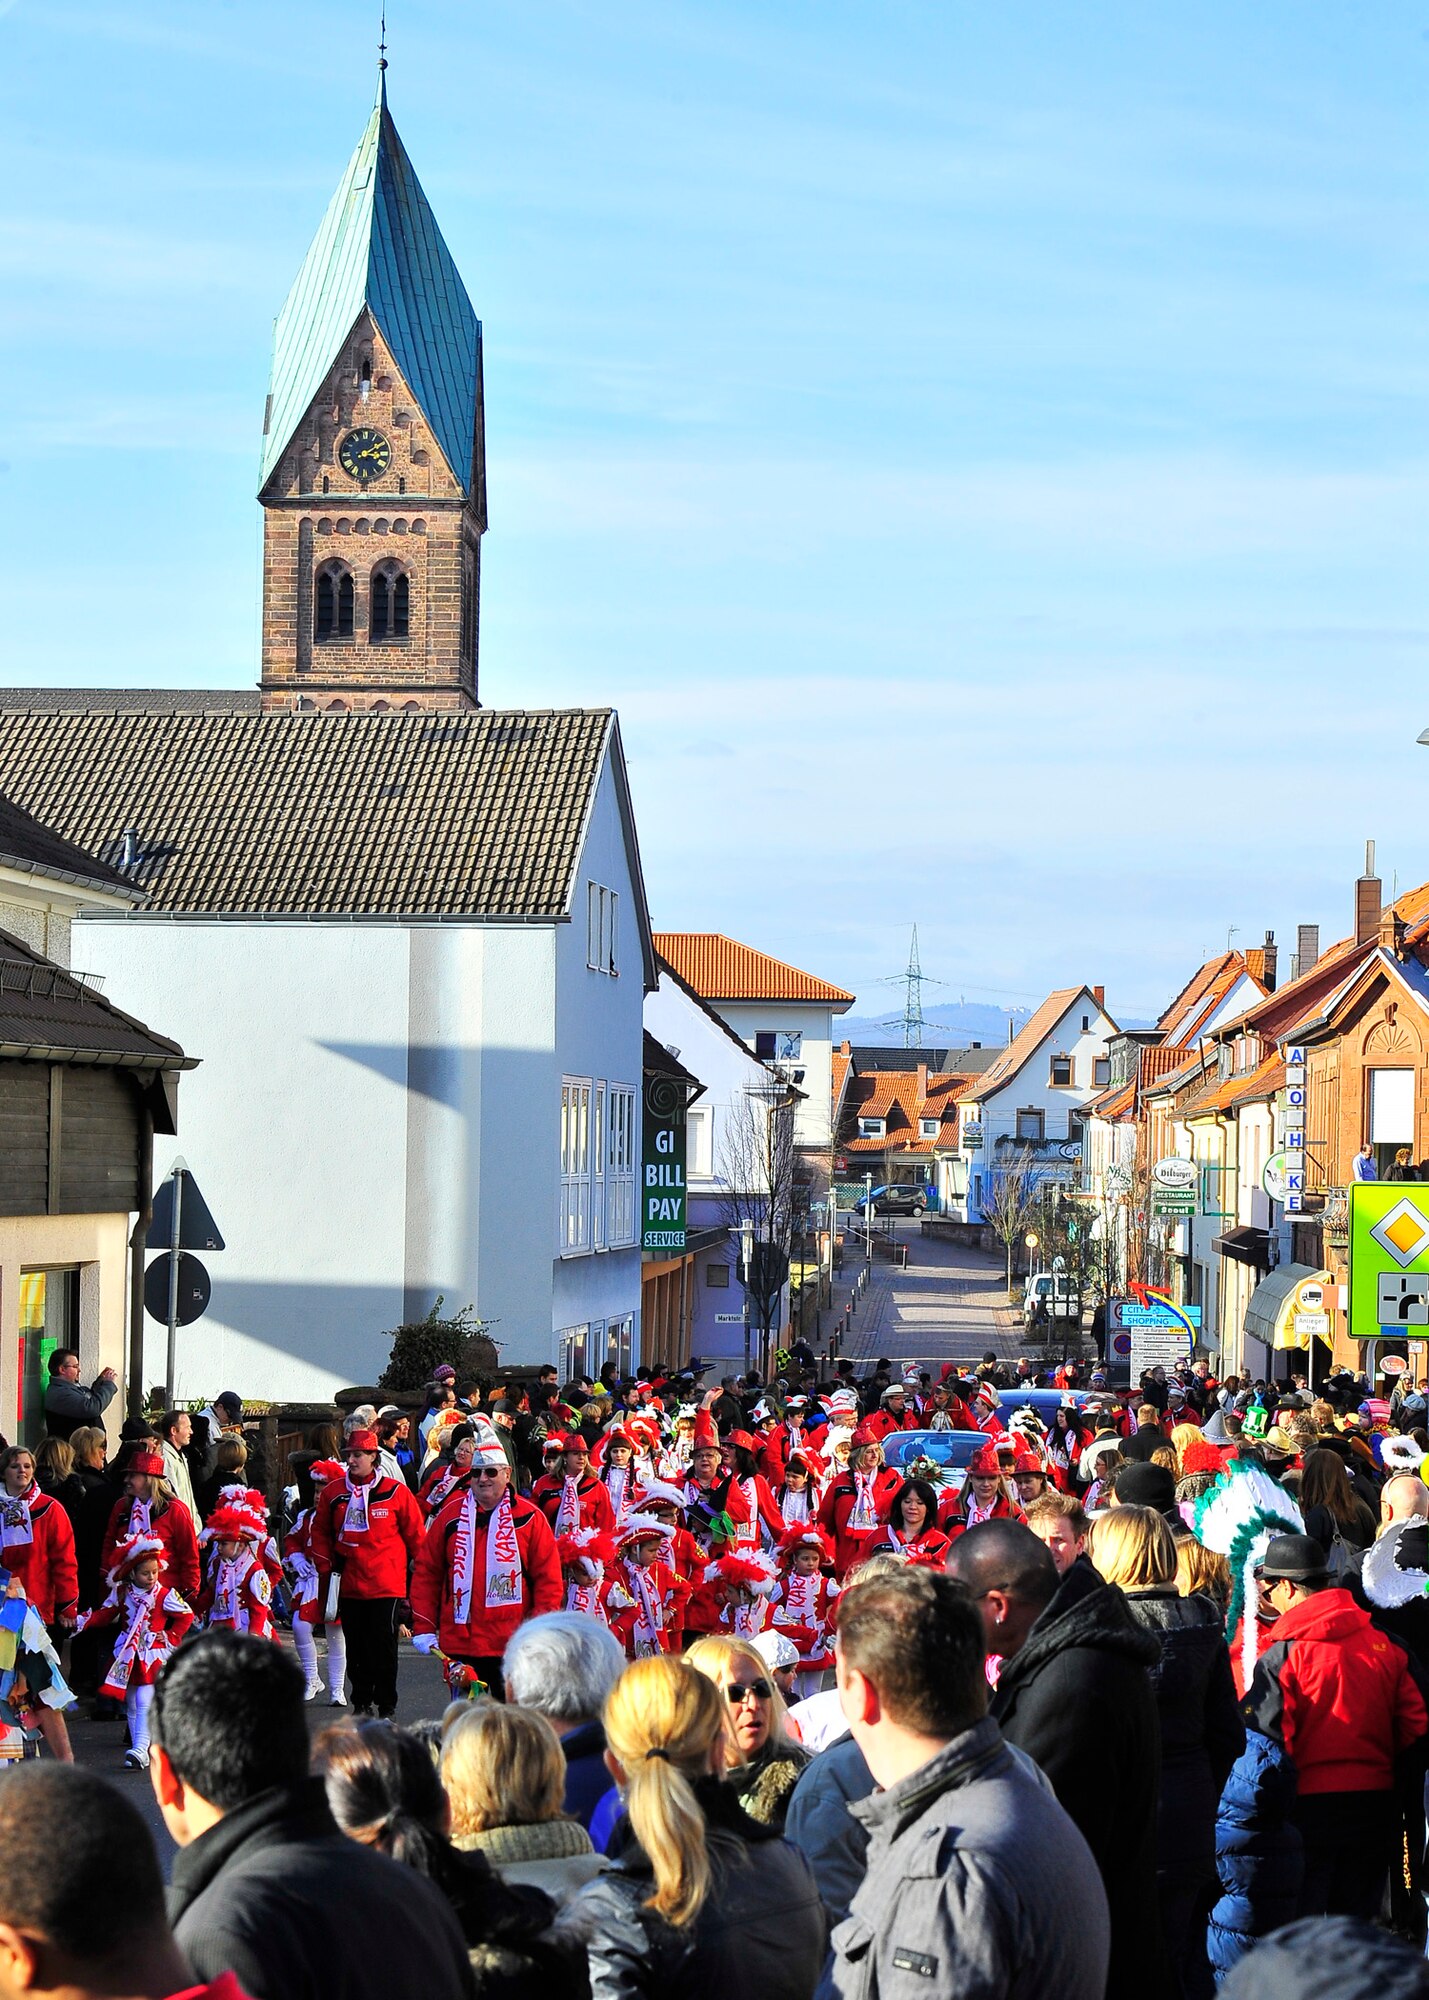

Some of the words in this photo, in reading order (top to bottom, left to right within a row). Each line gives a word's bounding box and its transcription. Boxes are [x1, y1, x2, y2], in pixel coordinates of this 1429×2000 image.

[655, 1130, 674, 1153] GI
[645, 1164, 685, 1187] BILL
[648, 1197, 682, 1221] PAY
[644, 1230, 686, 1247] SERVICE
[1127, 1317, 1169, 1325] SHOPPING
[1298, 1317, 1325, 1326] Anlieger
